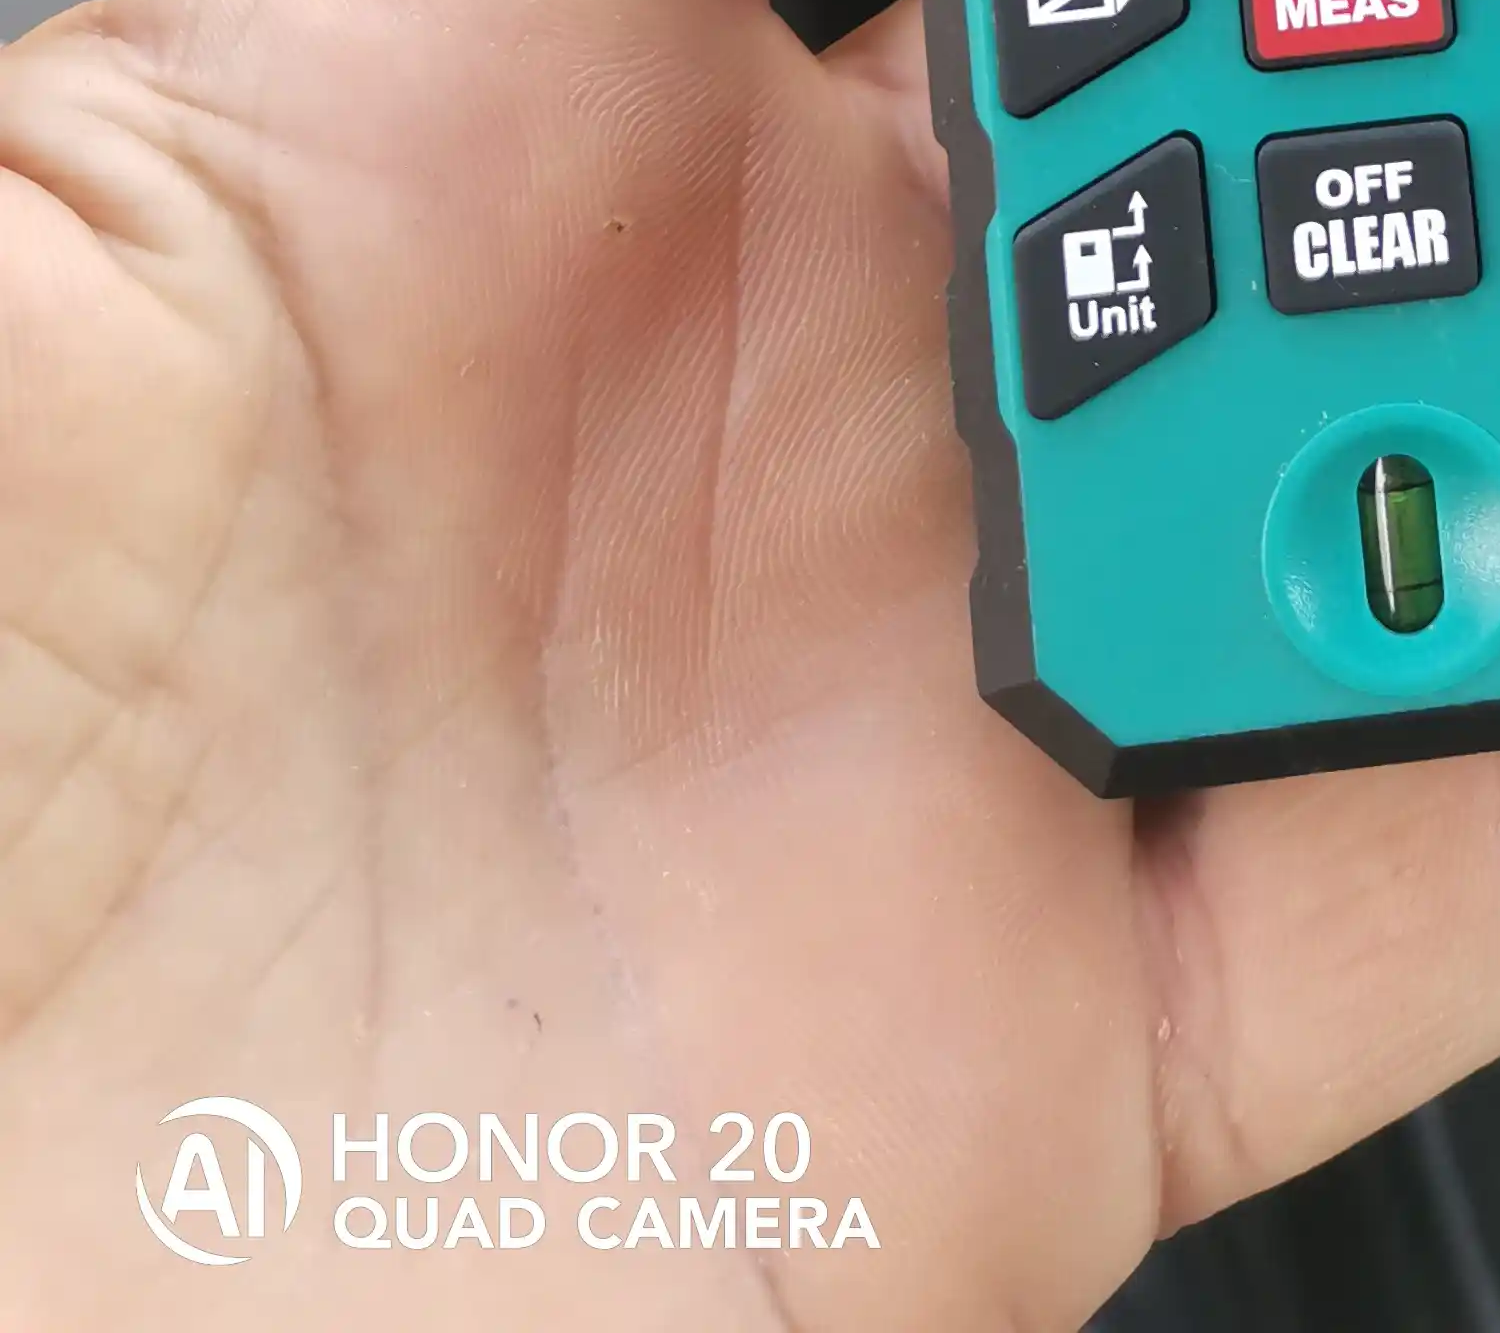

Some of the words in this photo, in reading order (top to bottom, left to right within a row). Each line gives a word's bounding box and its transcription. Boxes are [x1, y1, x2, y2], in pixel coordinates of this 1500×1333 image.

[1315, 161, 1413, 208] OFF
[1293, 208, 1449, 280] CLEAR
[1067, 292, 1158, 340] Unit
